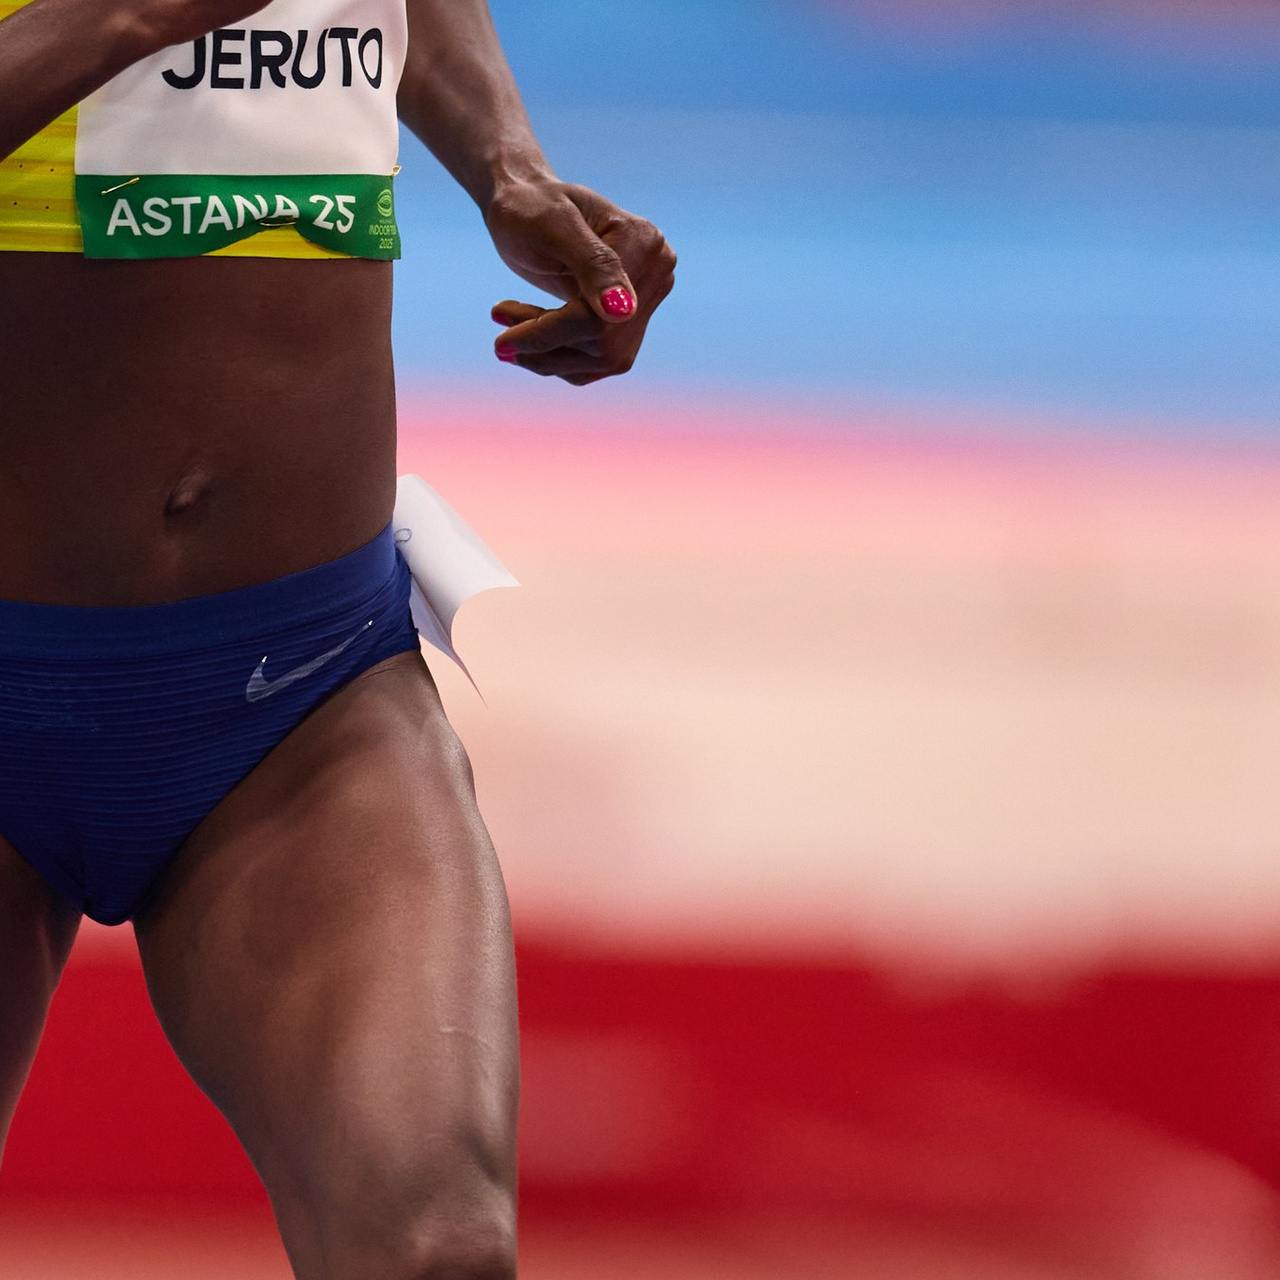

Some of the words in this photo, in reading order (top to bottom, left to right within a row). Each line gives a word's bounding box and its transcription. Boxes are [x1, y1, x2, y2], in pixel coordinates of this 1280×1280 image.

[161, 27, 383, 90] JERUTO
[106, 194, 300, 236] ASTANA
[308, 194, 357, 234] 25
